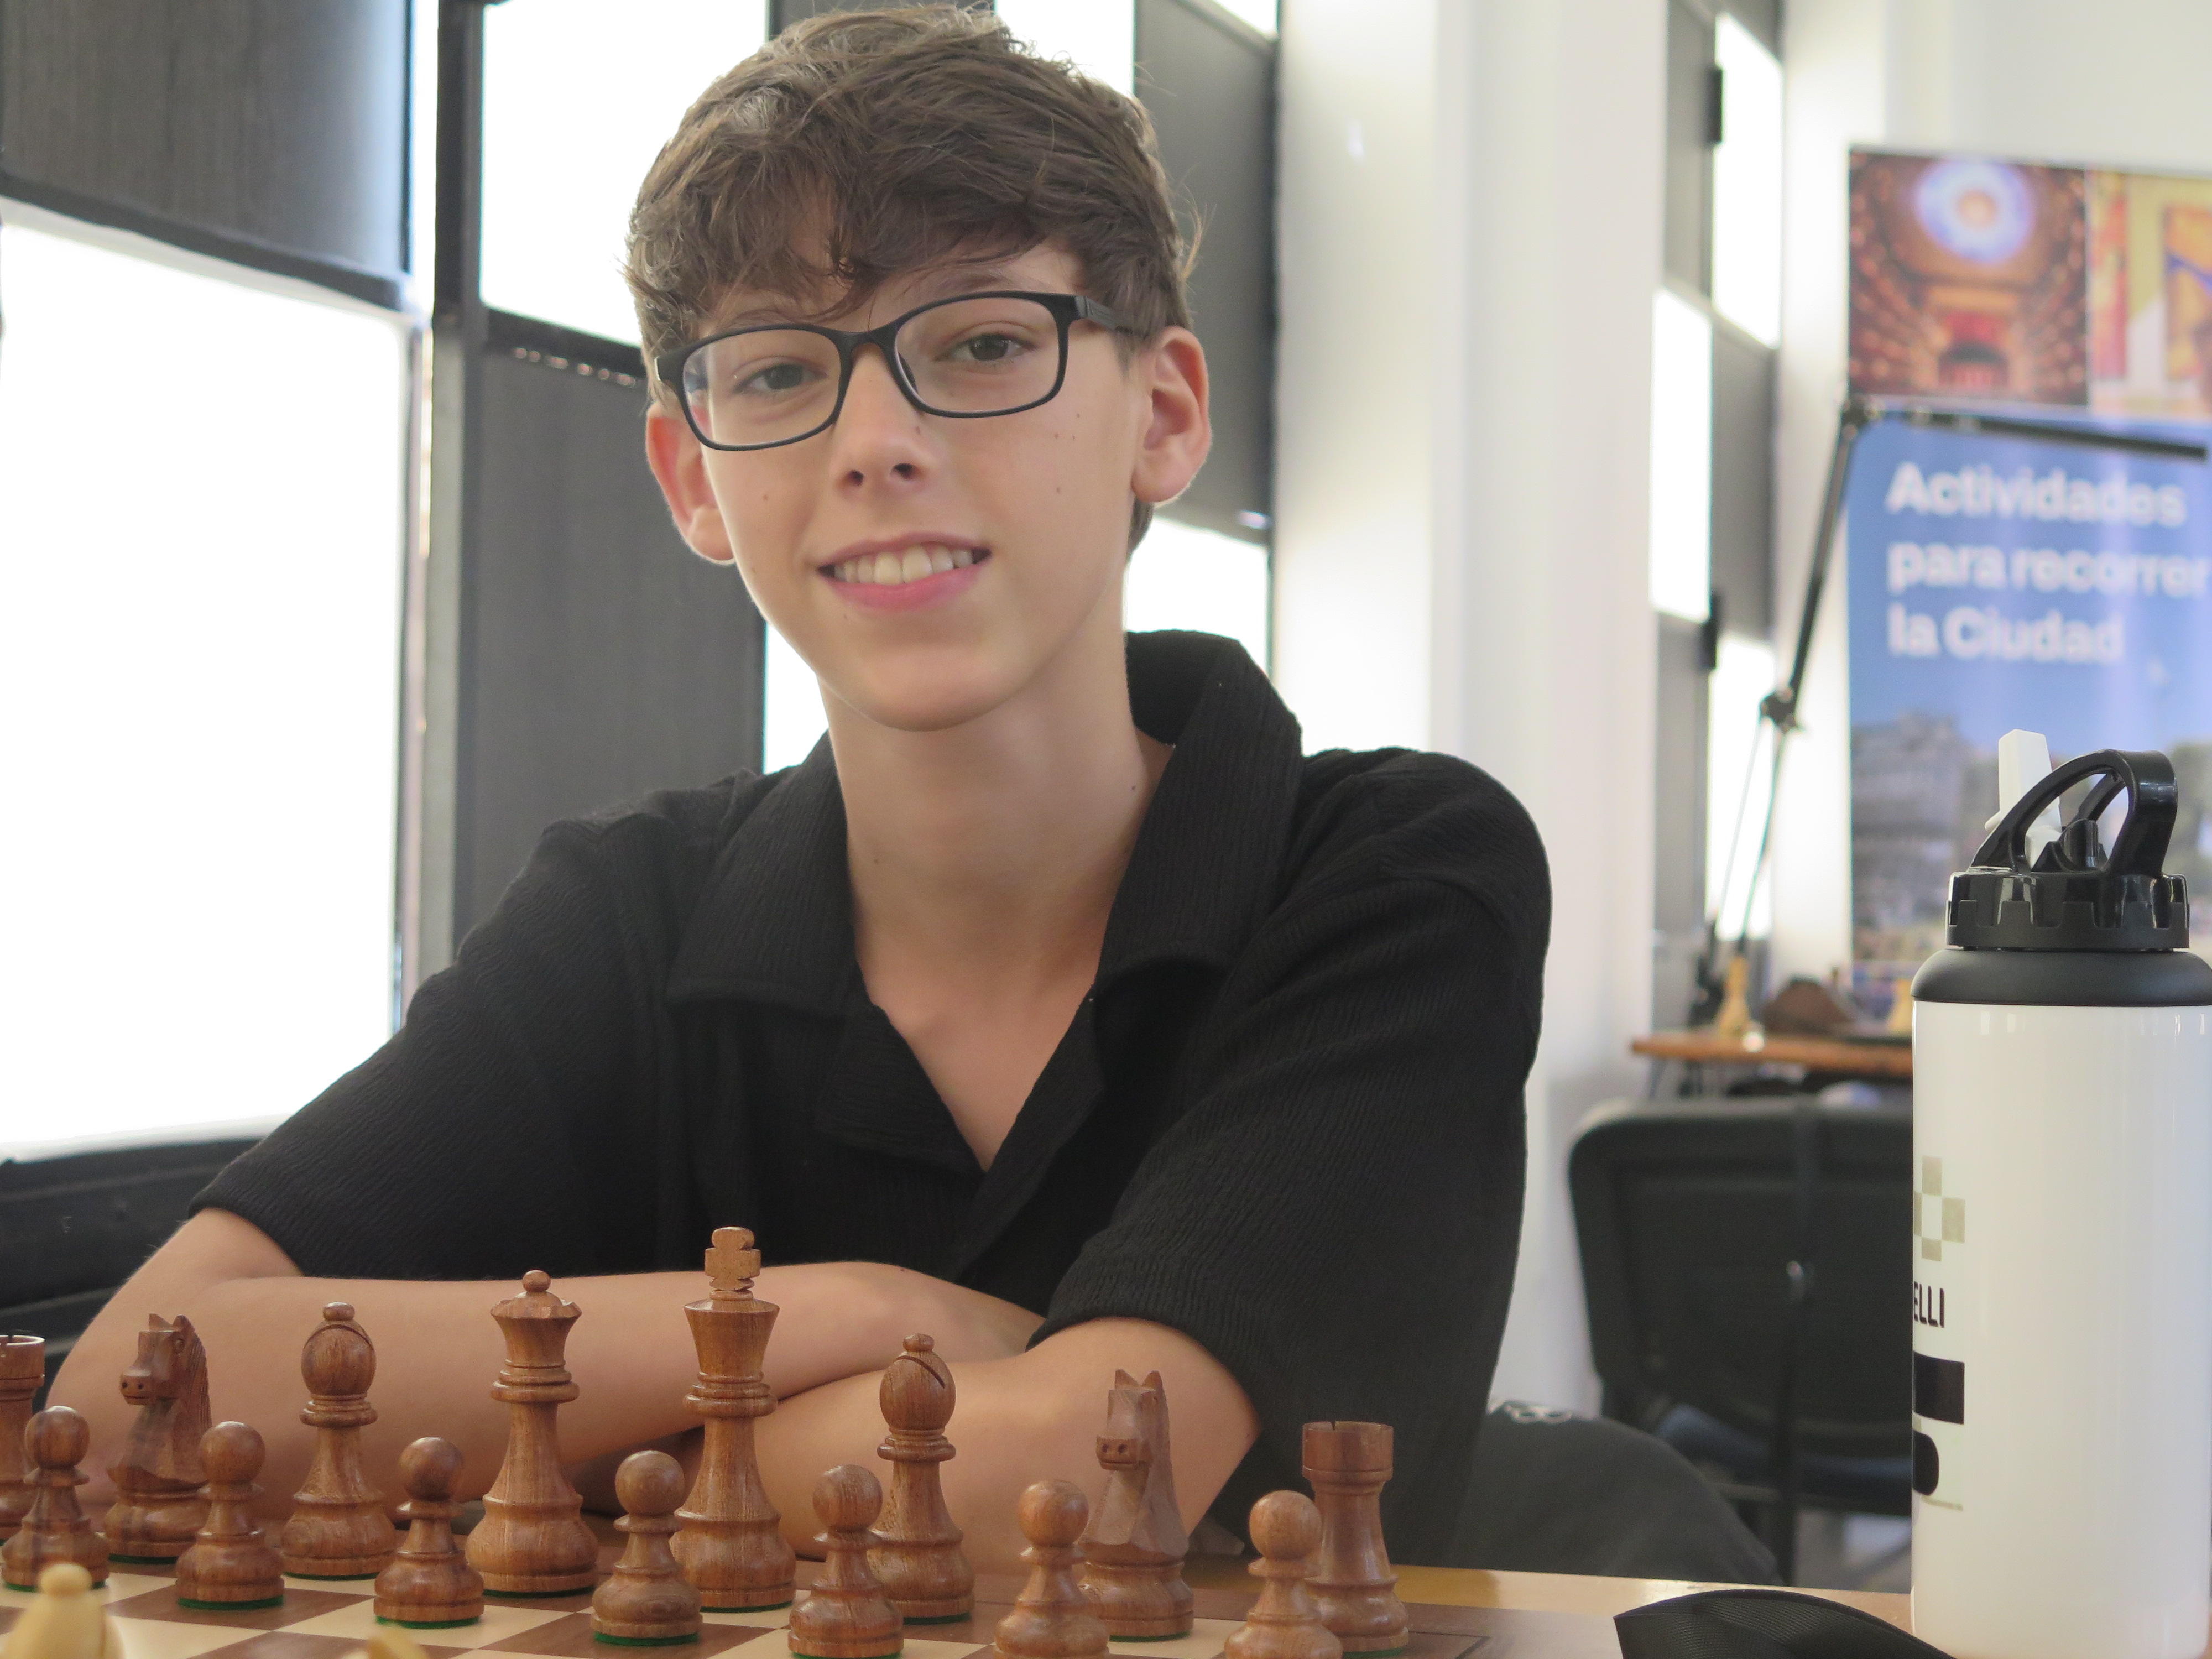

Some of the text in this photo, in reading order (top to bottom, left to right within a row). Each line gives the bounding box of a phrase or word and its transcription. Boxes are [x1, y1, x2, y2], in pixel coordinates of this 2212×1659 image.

[1885, 461, 2187, 528] Actividades
[1887, 542, 2210, 598] para recorrer
[1888, 603, 2125, 661] la Ciudad
